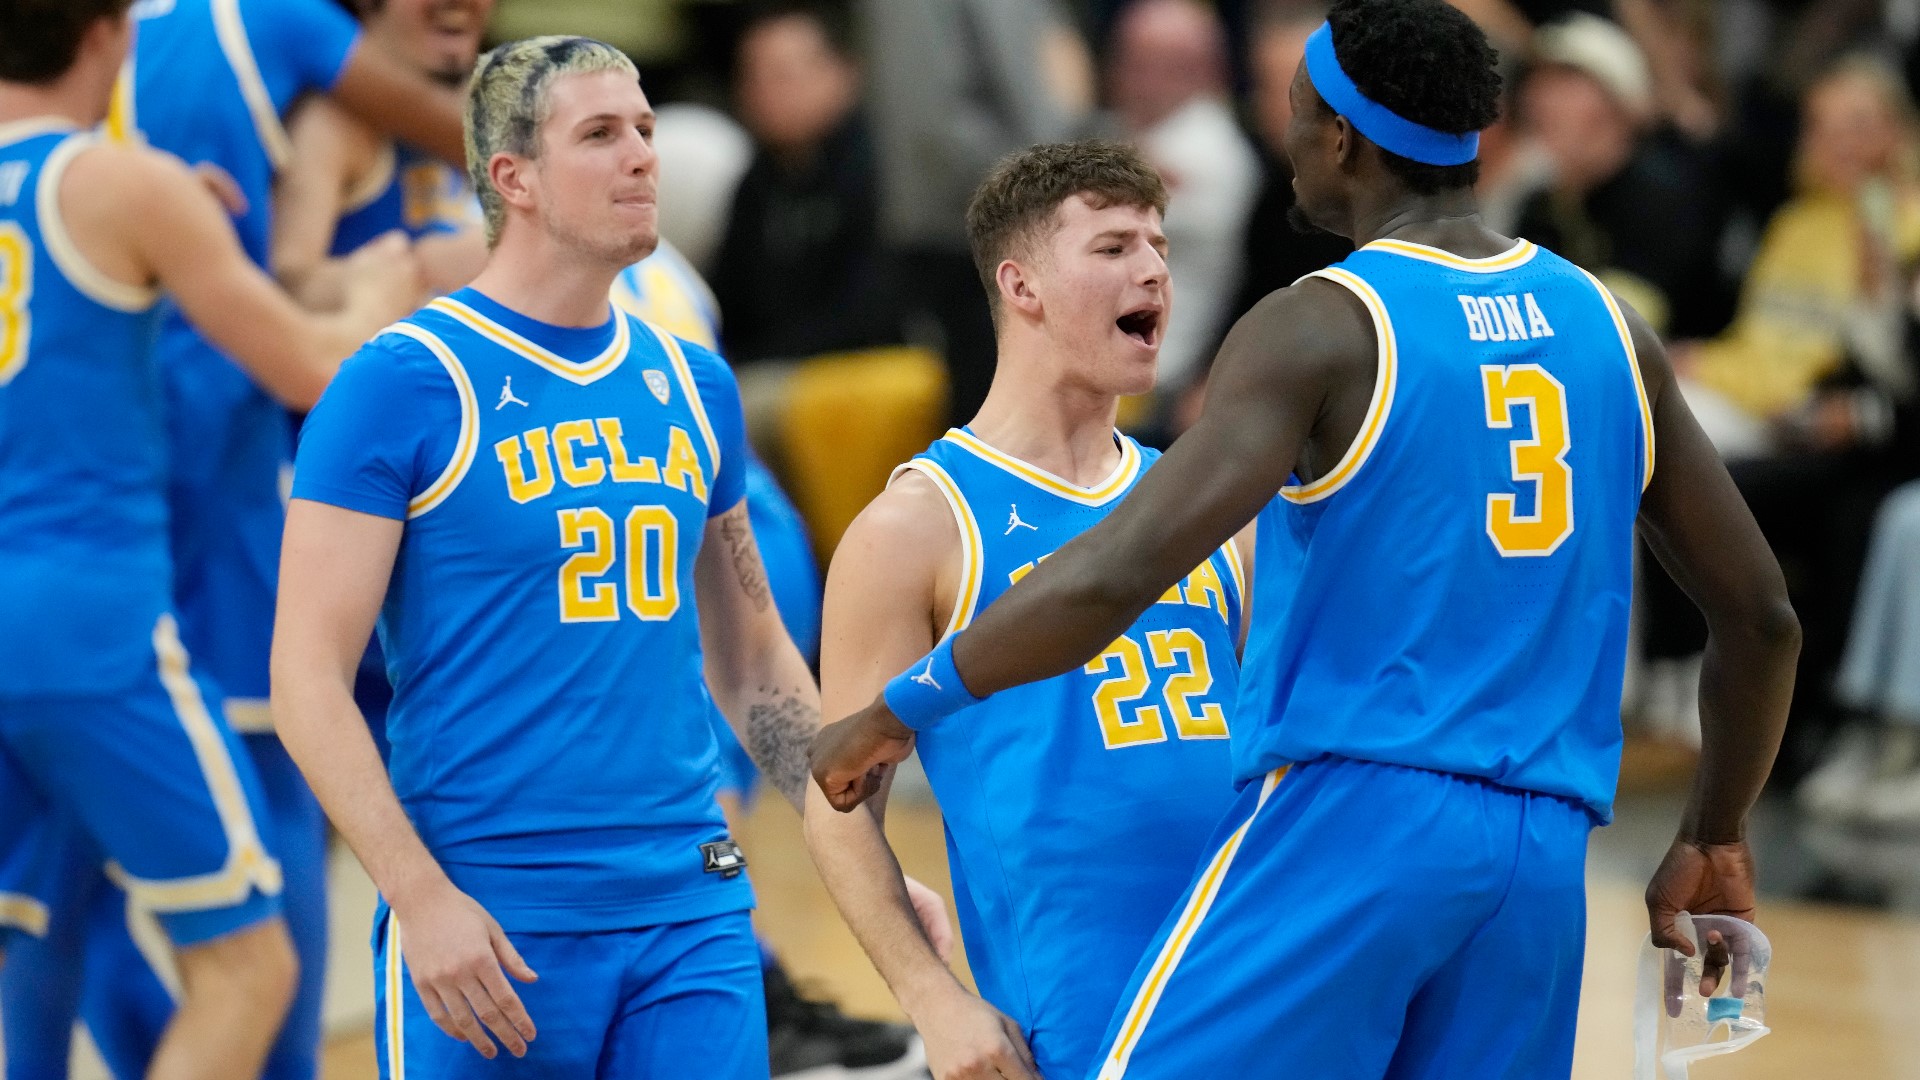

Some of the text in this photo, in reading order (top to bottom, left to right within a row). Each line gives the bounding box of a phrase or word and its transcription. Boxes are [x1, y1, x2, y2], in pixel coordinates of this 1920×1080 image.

[1457, 292, 1555, 341] BONA
[494, 417, 708, 505] UCLA
[1480, 363, 1575, 558] 3
[556, 504, 680, 624] 20
[1083, 627, 1231, 750] 22
